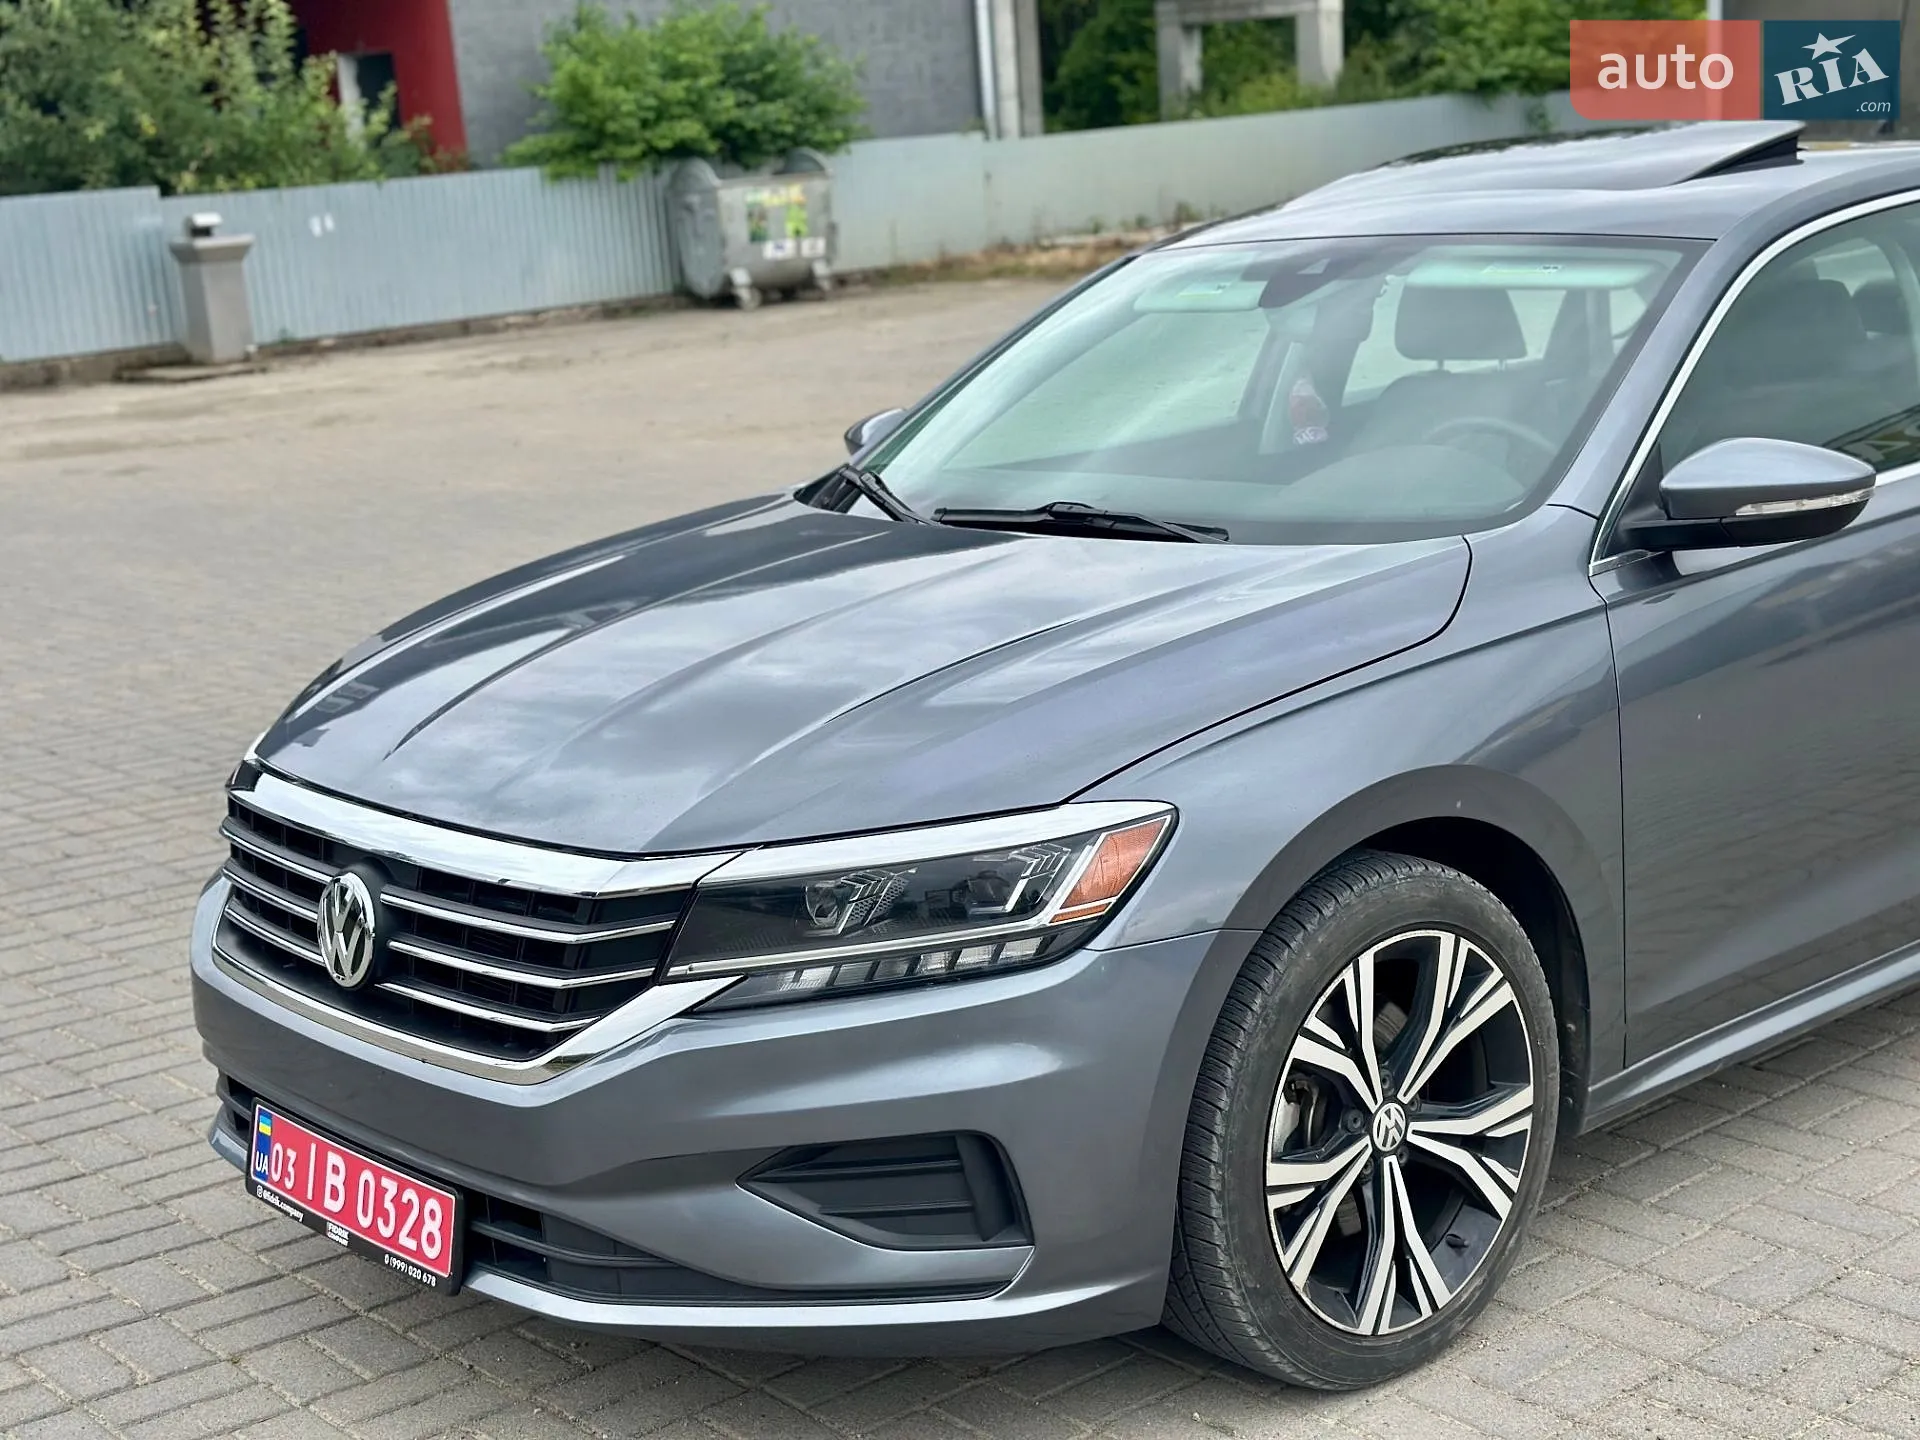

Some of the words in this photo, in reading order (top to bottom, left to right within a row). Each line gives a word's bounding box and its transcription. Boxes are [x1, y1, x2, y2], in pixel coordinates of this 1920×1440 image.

[255, 1151, 269, 1175] UA
[270, 1142, 297, 1190] 03
[356, 1169, 443, 1260] 0328
[422, 1272, 437, 1287] 678
